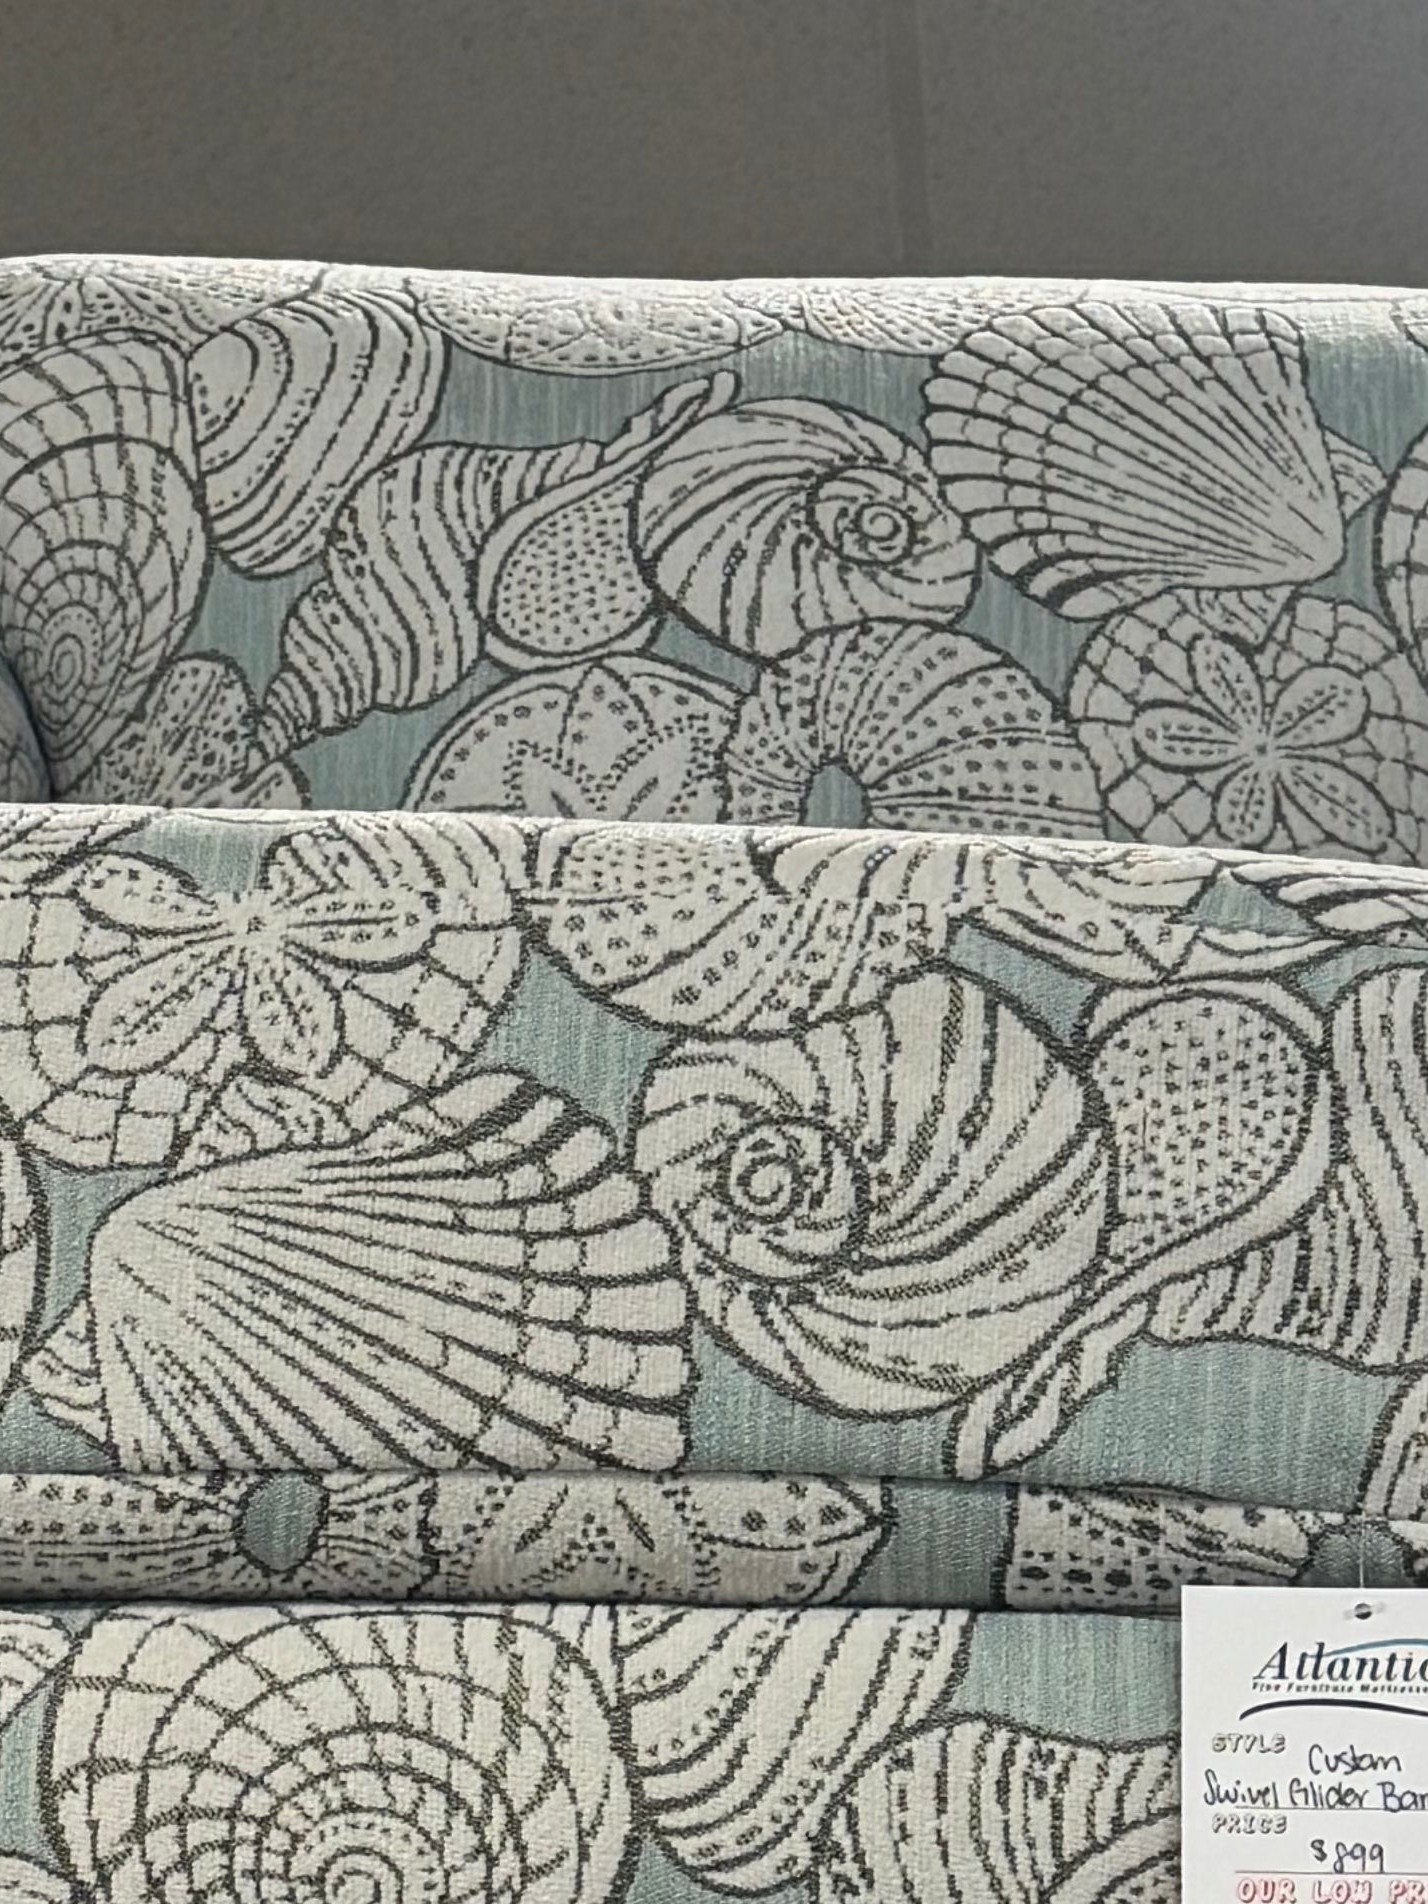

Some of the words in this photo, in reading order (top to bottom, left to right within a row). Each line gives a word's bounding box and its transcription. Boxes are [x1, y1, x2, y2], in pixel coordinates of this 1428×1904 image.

[1212, 1732, 1286, 1753] STYLE
[1308, 1744, 1402, 1775] Custom
[1204, 1769, 1279, 1809] Swivel
[1289, 1777, 1370, 1808] Glider
[1212, 1813, 1288, 1834] PRICE
[1310, 1839, 1385, 1874] $899
[1236, 1878, 1298, 1904] OUR
[1312, 1879, 1373, 1904] LOW
